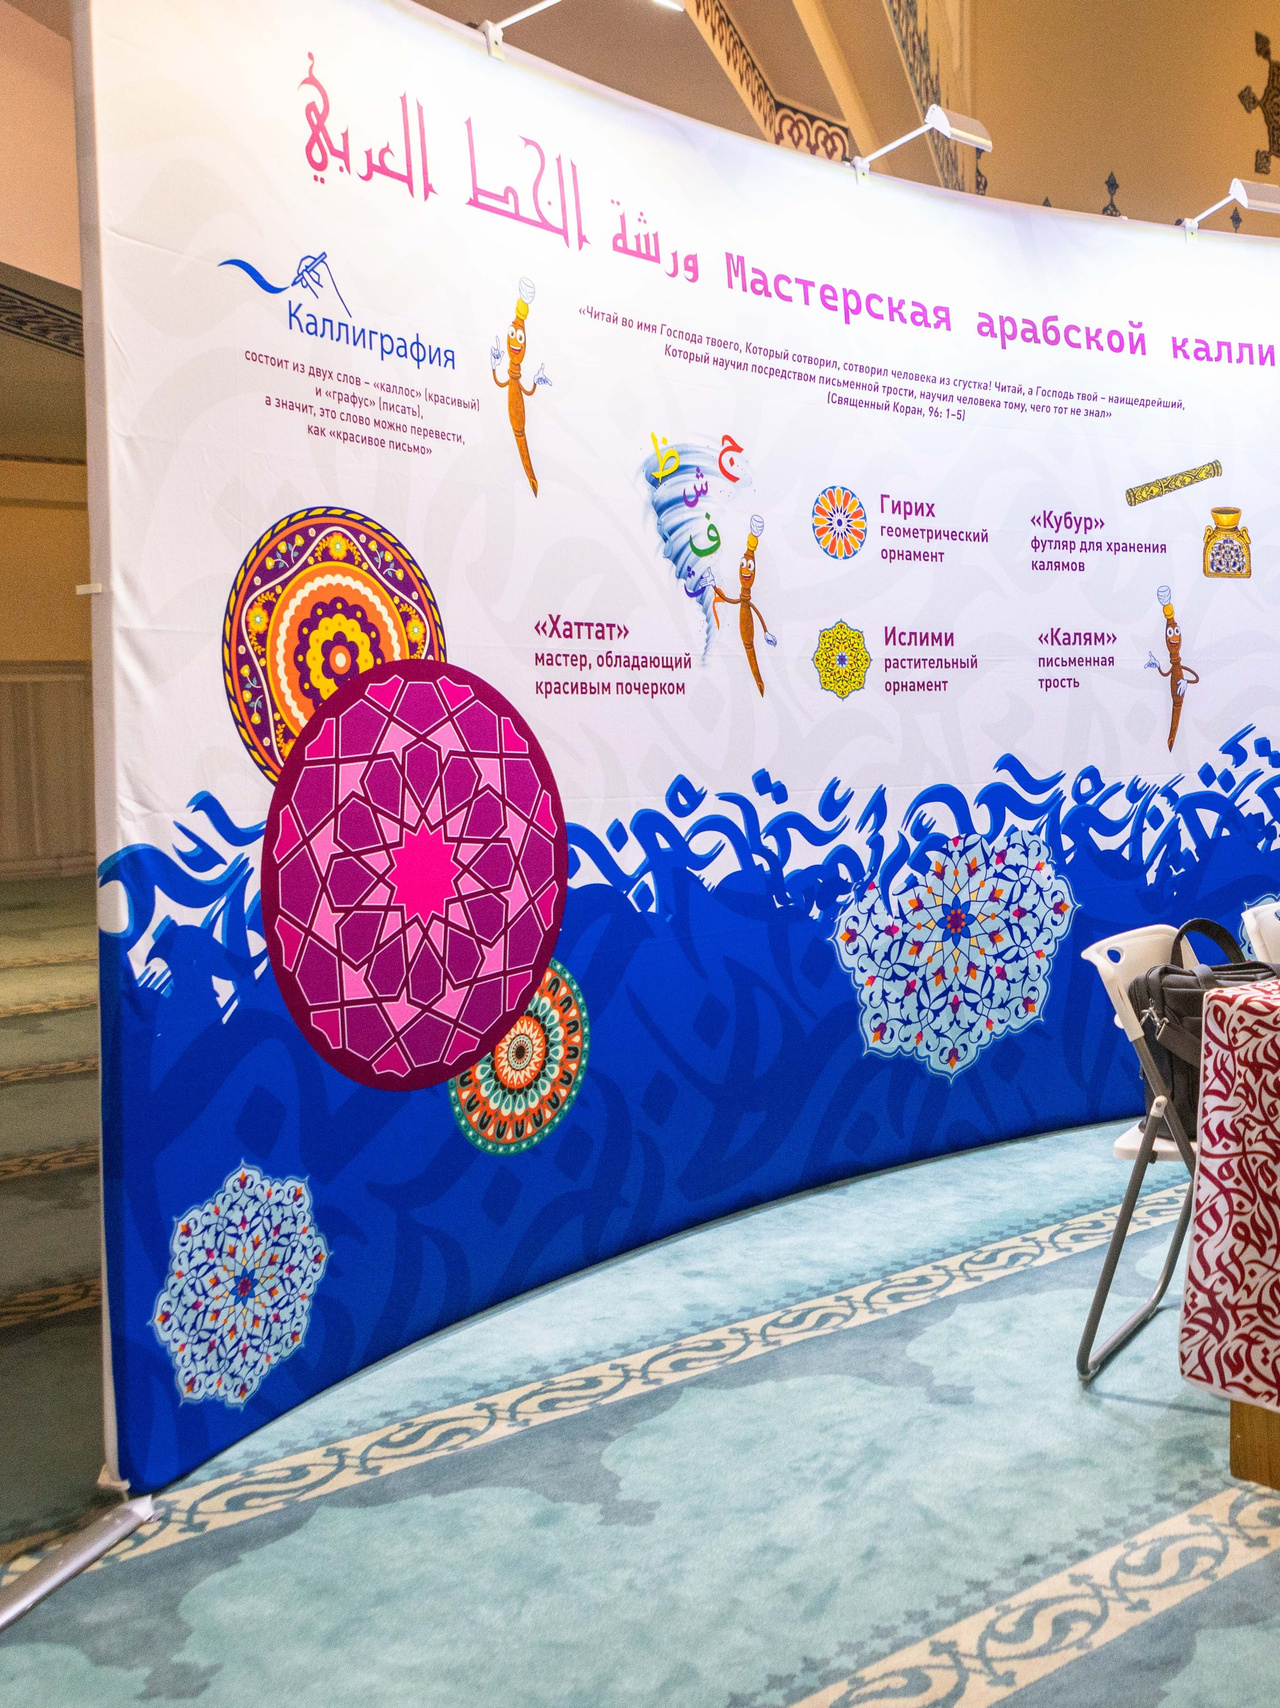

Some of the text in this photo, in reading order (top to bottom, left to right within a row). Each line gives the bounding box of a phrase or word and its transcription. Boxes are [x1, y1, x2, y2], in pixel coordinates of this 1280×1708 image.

[297, 52, 700, 283] ورشة الخط العربي
[725, 252, 951, 331] Мастерская
[976, 311, 1147, 356] арабской
[288, 300, 456, 370] Каллиграфия
[578, 305, 619, 325] «Читай
[622, 316, 634, 329] во
[637, 320, 657, 334] имя
[660, 324, 703, 345] Господа
[705, 336, 743, 354] твоего,
[745, 342, 789, 361] Который
[791, 352, 841, 372] сотворил,
[843, 361, 888, 378] сотворил
[891, 367, 937, 384] человека
[939, 375, 950, 386] из
[953, 377, 992, 392] сгустка!
[994, 382, 1026, 396] Читай,
[1027, 387, 1033, 396] а
[1036, 386, 1075, 402] Господь
[1076, 389, 1098, 402] твой
[1108, 394, 1186, 412] наищедрейший,
[244, 349, 290, 371] состоит
[292, 361, 305, 374] из
[308, 364, 334, 382] двух
[336, 371, 362, 387] слов
[373, 381, 422, 399] «каллос»
[424, 387, 480, 412] (красивый)
[664, 344, 1112, 419] Который научил посредством письменной трости, научил человека тому, чего тот не знал»
[315, 386, 424, 420] и «графус» (писать),
[827, 390, 891, 413] (Священный
[893, 401, 926, 417] Коран,
[928, 406, 942, 419] 96:
[265, 394, 466, 445] а значит, это слово можно перевести,
[307, 424, 433, 456] как «красивое письмо»
[718, 434, 744, 483] ج
[880, 494, 936, 520] Гирих
[689, 512, 721, 558] ف
[880, 525, 989, 543] геометрический
[1030, 510, 1105, 534] «Кубур»
[880, 548, 945, 563] орнамент
[1031, 536, 1167, 555] футляр для хранения
[1031, 560, 1085, 572] калямов
[534, 613, 630, 641] «Хаттат»
[884, 626, 955, 647] Ислими
[1038, 627, 1118, 646] «Калям»
[534, 651, 692, 671] мастер, обладающий
[884, 654, 978, 672] растительный
[1038, 656, 1115, 667] письменная
[535, 680, 686, 699] красивым почерком
[884, 680, 949, 695] орнамент
[1038, 677, 1080, 692] трость
